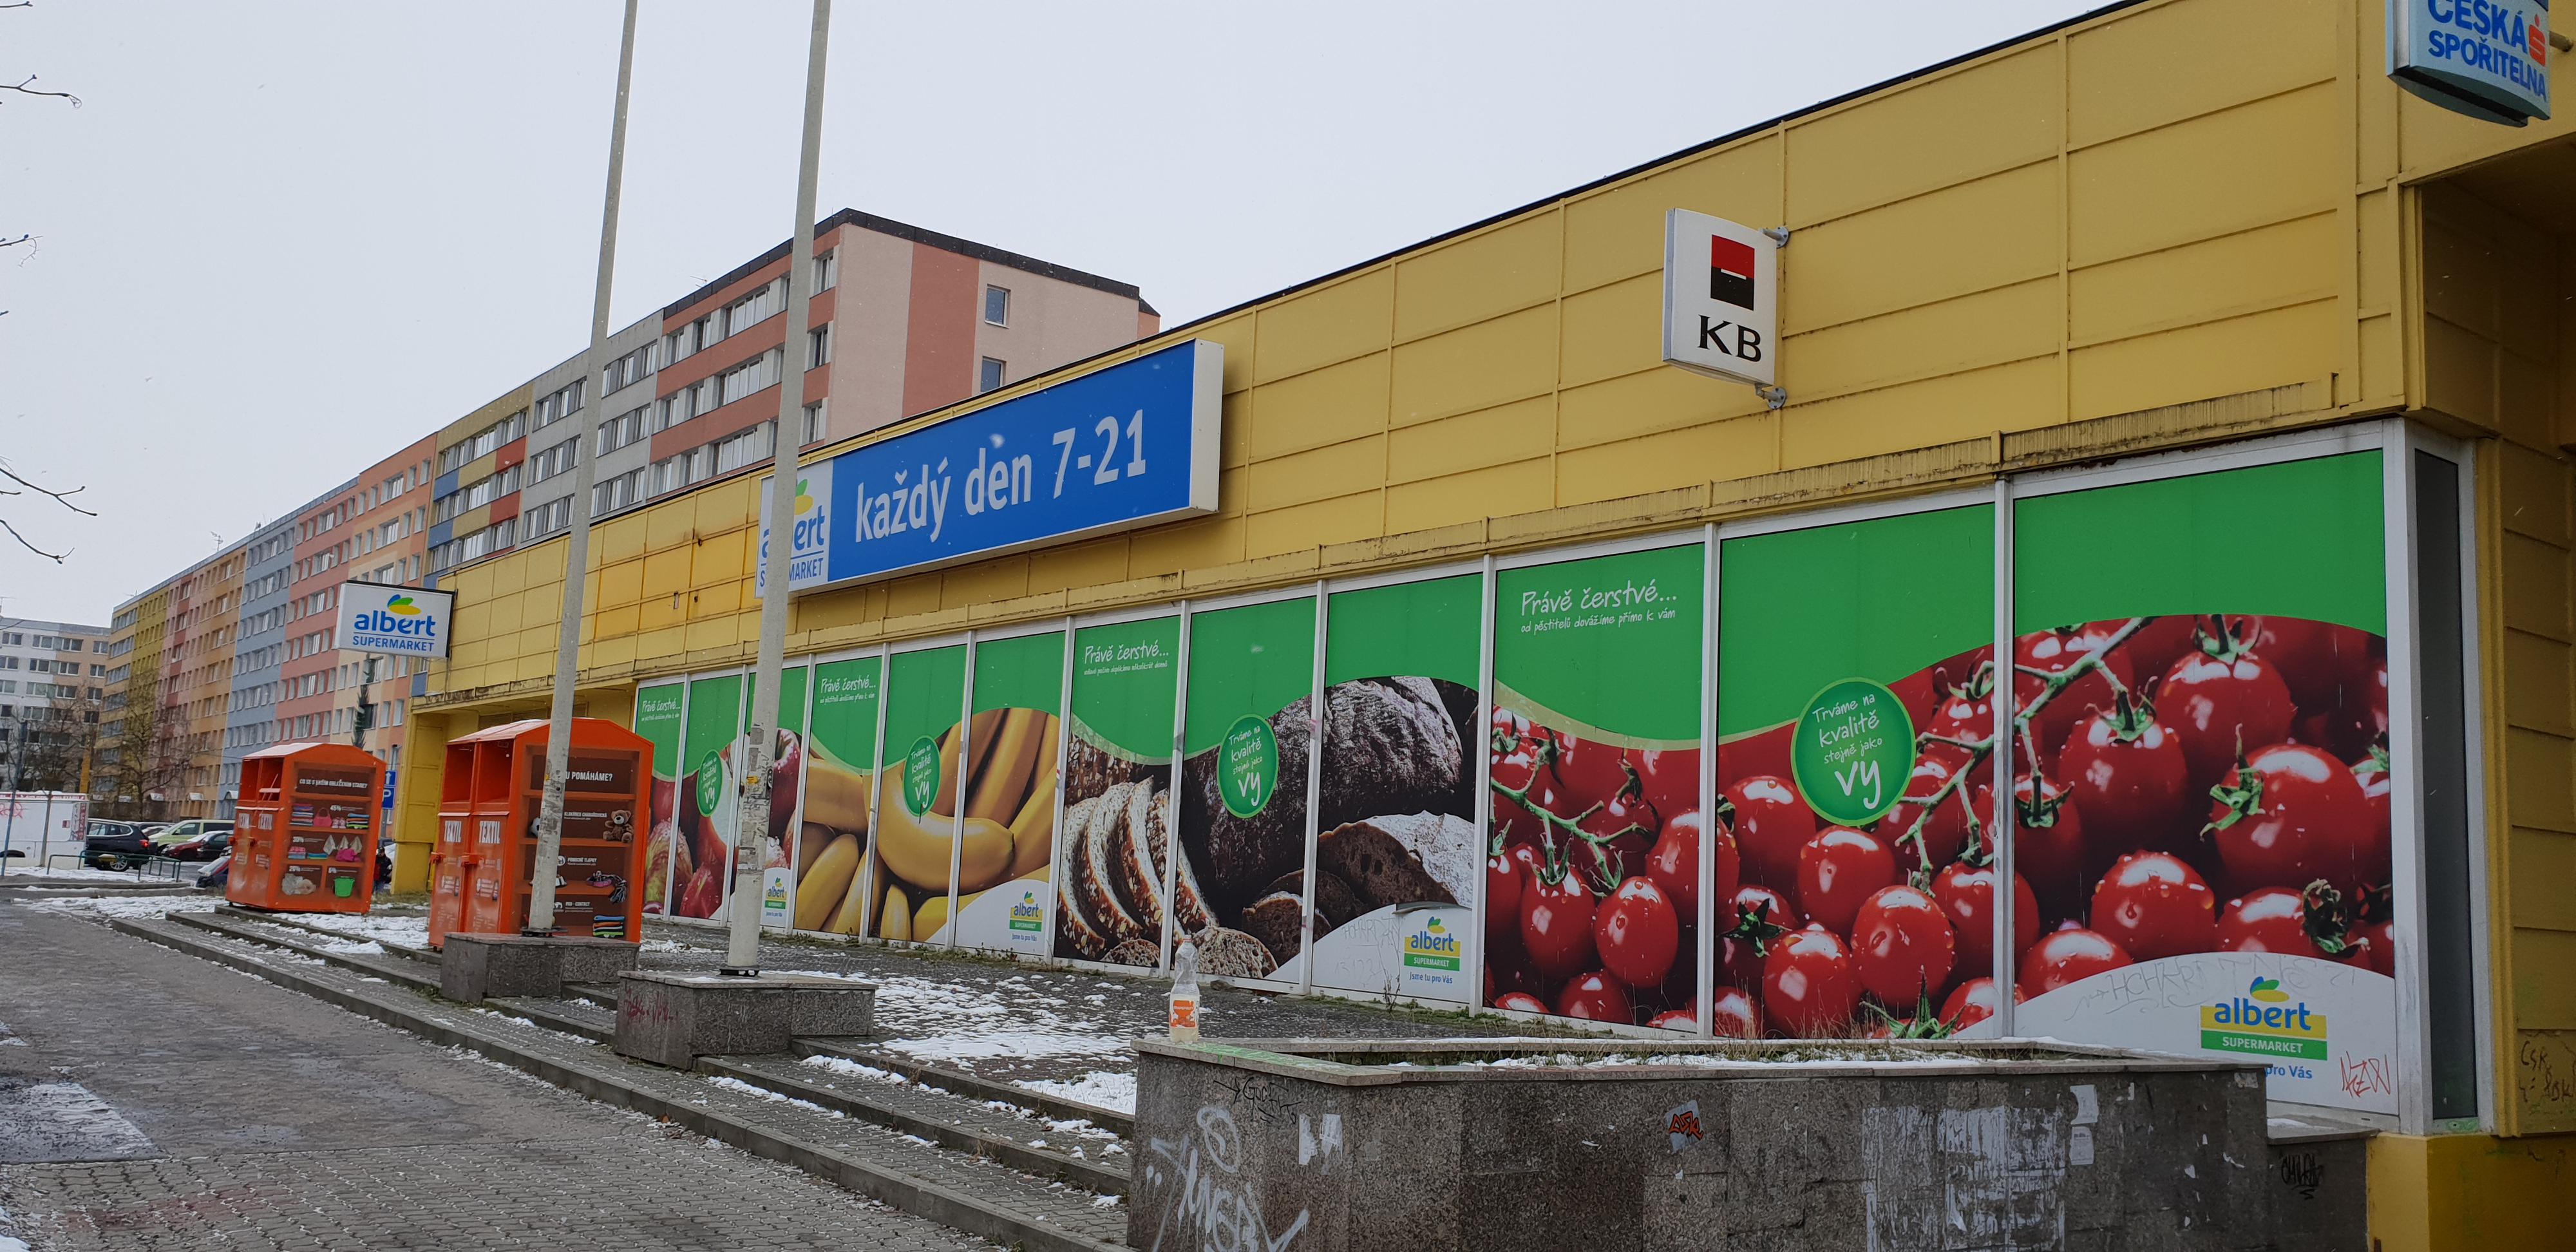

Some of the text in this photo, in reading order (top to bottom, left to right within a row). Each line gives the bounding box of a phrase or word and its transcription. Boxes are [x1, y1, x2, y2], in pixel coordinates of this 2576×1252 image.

[2428, 30, 2547, 102] SPOŘITELNA
[1697, 314, 1762, 363] KB
[855, 409, 1146, 543] každý den 7-21
[760, 558, 823, 587] SMARKET
[1521, 578, 1678, 616] Právě čerstvé...
[354, 610, 436, 637] albert
[1520, 607, 1676, 636] od pěstitelů dovážíme přímo k vám
[352, 635, 435, 652] SUPERMARKET
[1084, 639, 1169, 664] Právě čerstvé...
[820, 678, 840, 694] Právě
[1812, 694, 1876, 723] Trváme na
[1229, 730, 1252, 746] Trváme
[1819, 709, 1880, 748] kvalitě
[1231, 736, 1262, 763] kvalitě
[1824, 737, 1883, 764] stejně jako
[571, 771, 613, 782] POMÁHÁME?
[768, 886, 784, 898] albert
[1014, 902, 1039, 918] albert
[1410, 931, 1454, 952] albert
[1413, 956, 1450, 968] SUPERMARKET
[1409, 971, 1453, 984] Jsme tu pro Vás
[2214, 997, 2311, 1030] albert
[2222, 1036, 2304, 1054] SUPERMARKET
[2289, 1065, 2313, 1079] Vás
